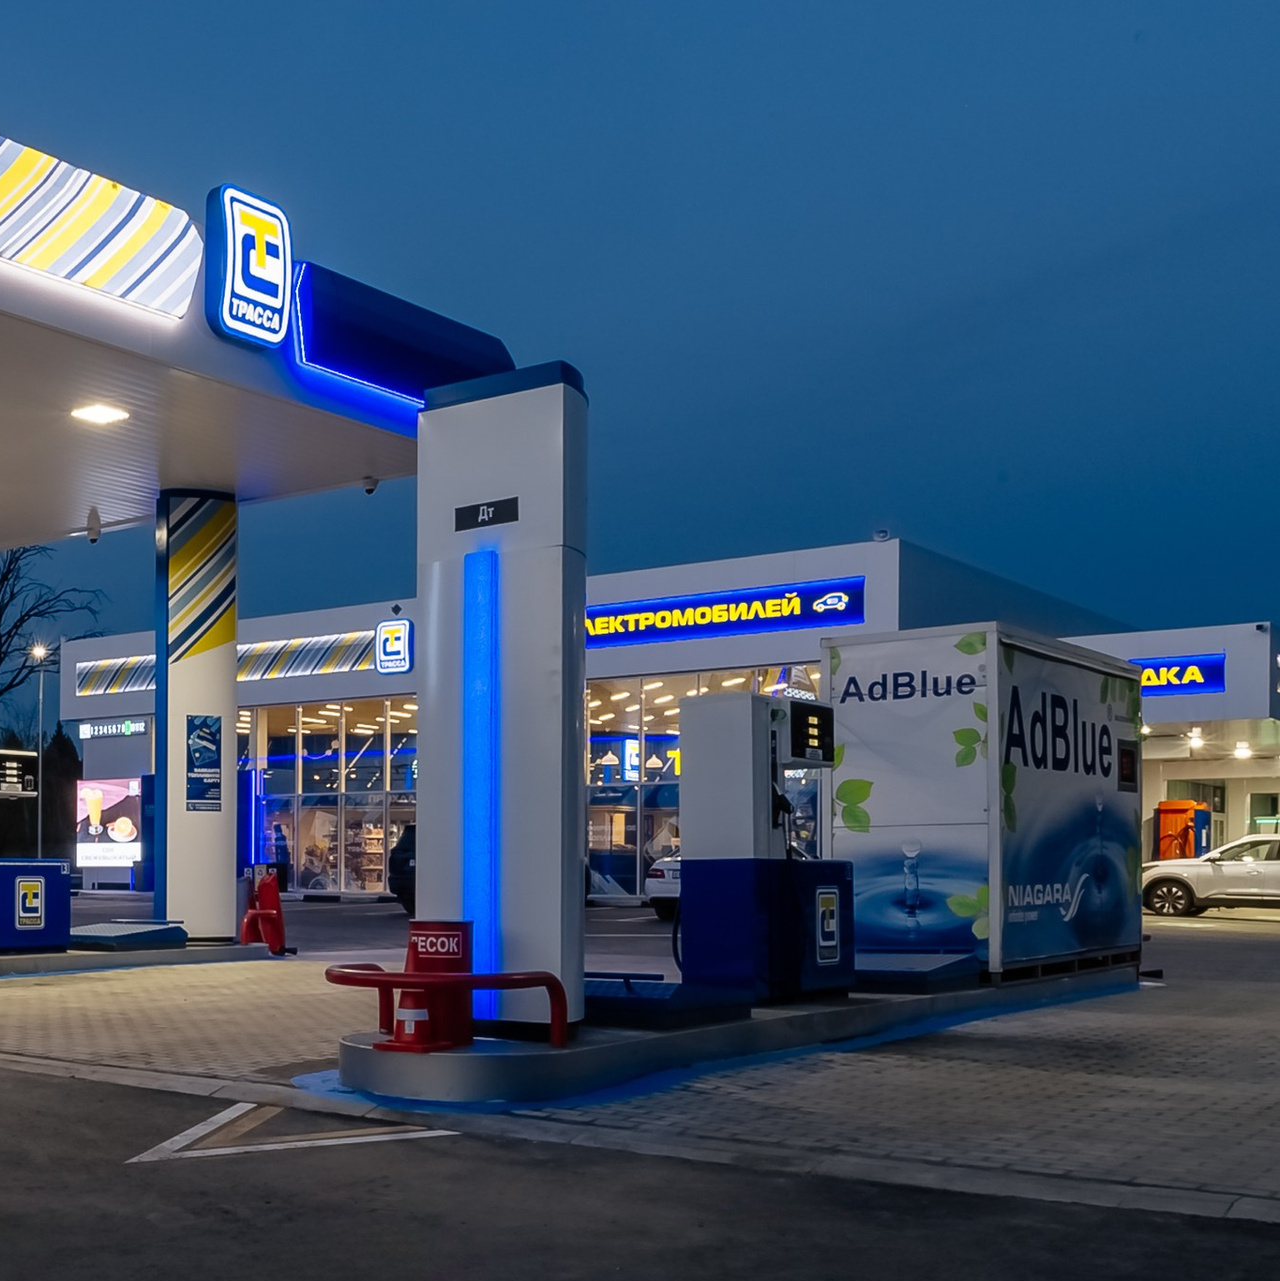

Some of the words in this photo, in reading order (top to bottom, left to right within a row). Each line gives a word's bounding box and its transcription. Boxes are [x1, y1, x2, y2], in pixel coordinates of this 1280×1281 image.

[231, 297, 280, 331] ТРАССА
[478, 505, 495, 523] Дт
[839, 670, 977, 704] AdBlue
[1004, 685, 1112, 778] AdBlue
[1008, 882, 1072, 907] NIAGARA
